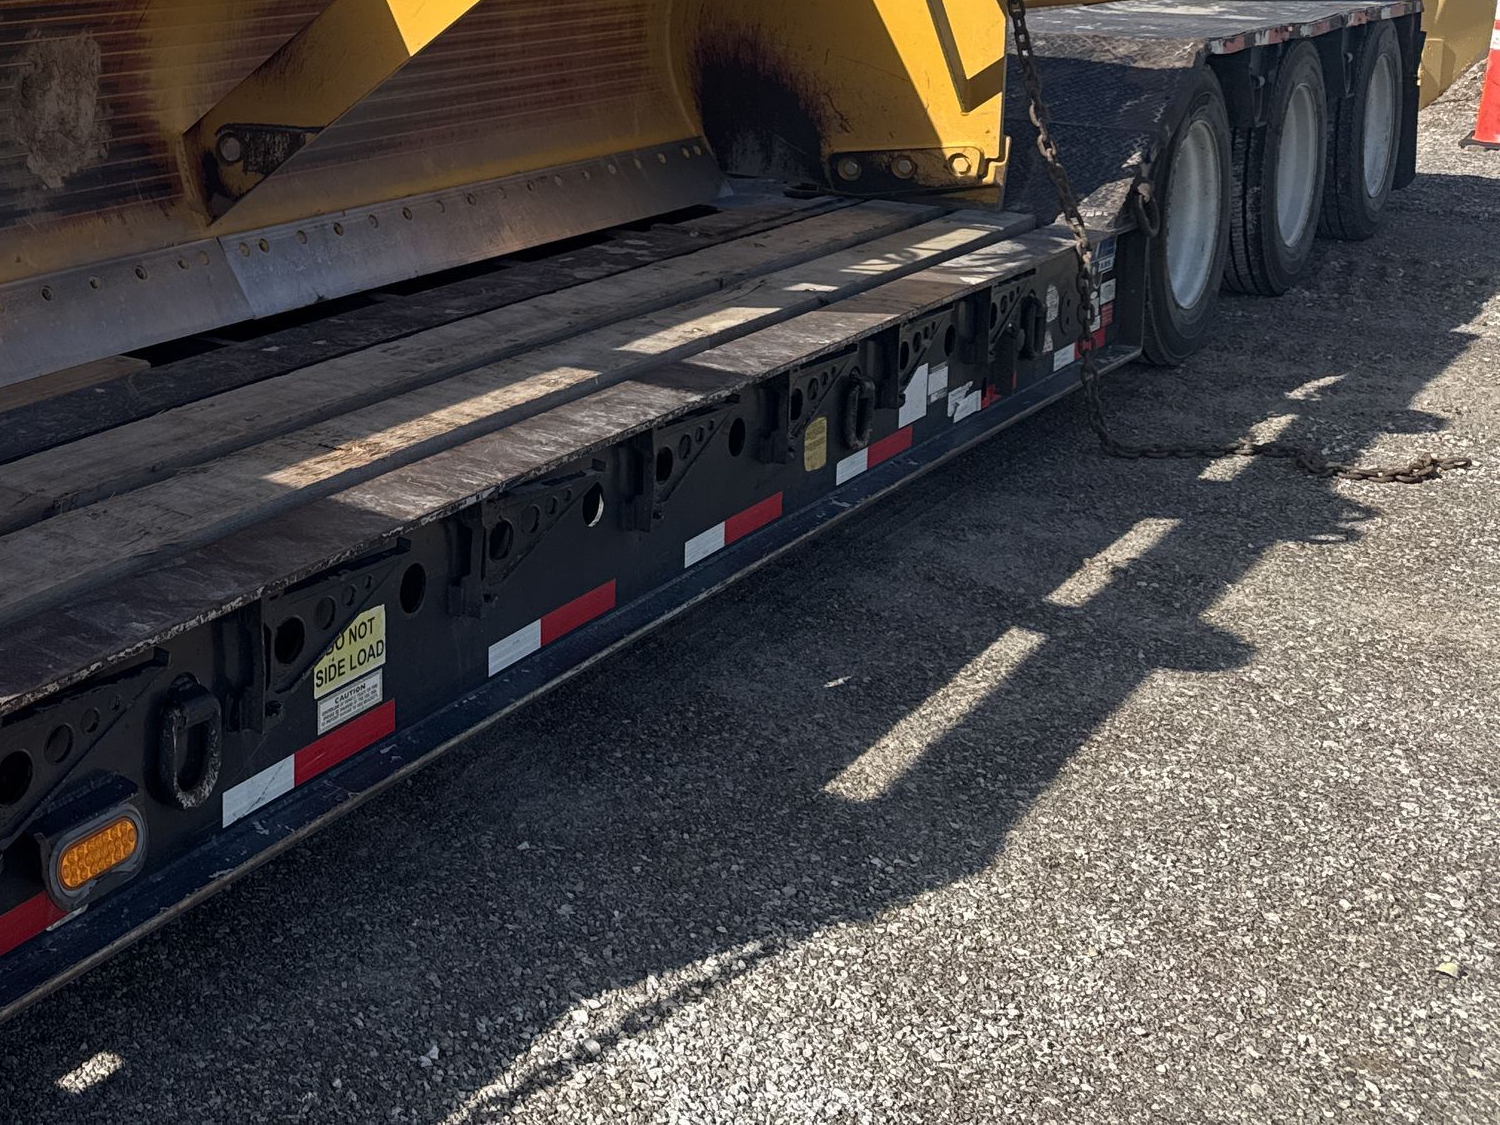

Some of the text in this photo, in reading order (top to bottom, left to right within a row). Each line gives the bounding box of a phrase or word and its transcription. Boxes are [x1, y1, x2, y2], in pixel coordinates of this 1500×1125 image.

[348, 616, 376, 645] NOT
[315, 640, 385, 688] SIDE LOAD
[334, 682, 366, 704] CAUTION
